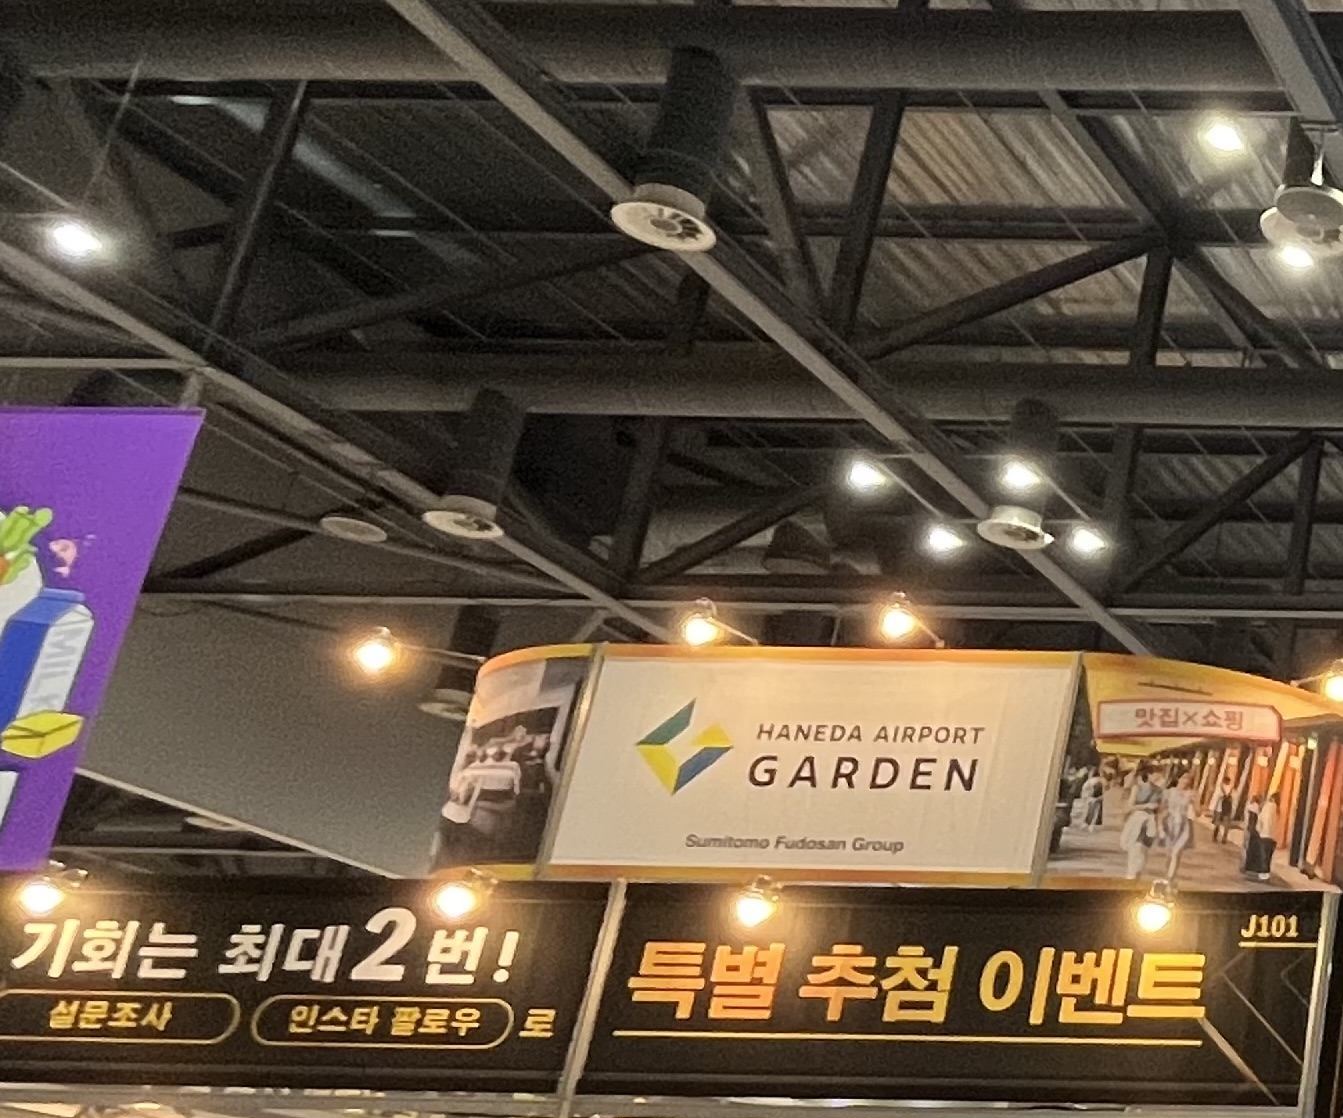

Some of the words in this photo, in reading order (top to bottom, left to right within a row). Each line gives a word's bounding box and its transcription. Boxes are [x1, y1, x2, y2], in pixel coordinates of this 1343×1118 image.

[756, 723, 862, 742] HANEDA
[874, 725, 985, 744] AIRPORT
[748, 755, 978, 792] GARDEN
[685, 834, 770, 850] Sumitomo
[774, 835, 846, 851] Fudosan
[851, 836, 904, 854] Group
[1241, 914, 1299, 938] J101
[11, 917, 199, 982] 기회는
[627, 941, 785, 1020] 특별
[797, 945, 959, 1023] 추첨
[979, 947, 1206, 1025] 이벤트
[47, 1003, 172, 1031] 설문조사
[287, 1005, 381, 1036] 인스타
[391, 1006, 481, 1036] 팔로우
[520, 1009, 555, 1037] 로
